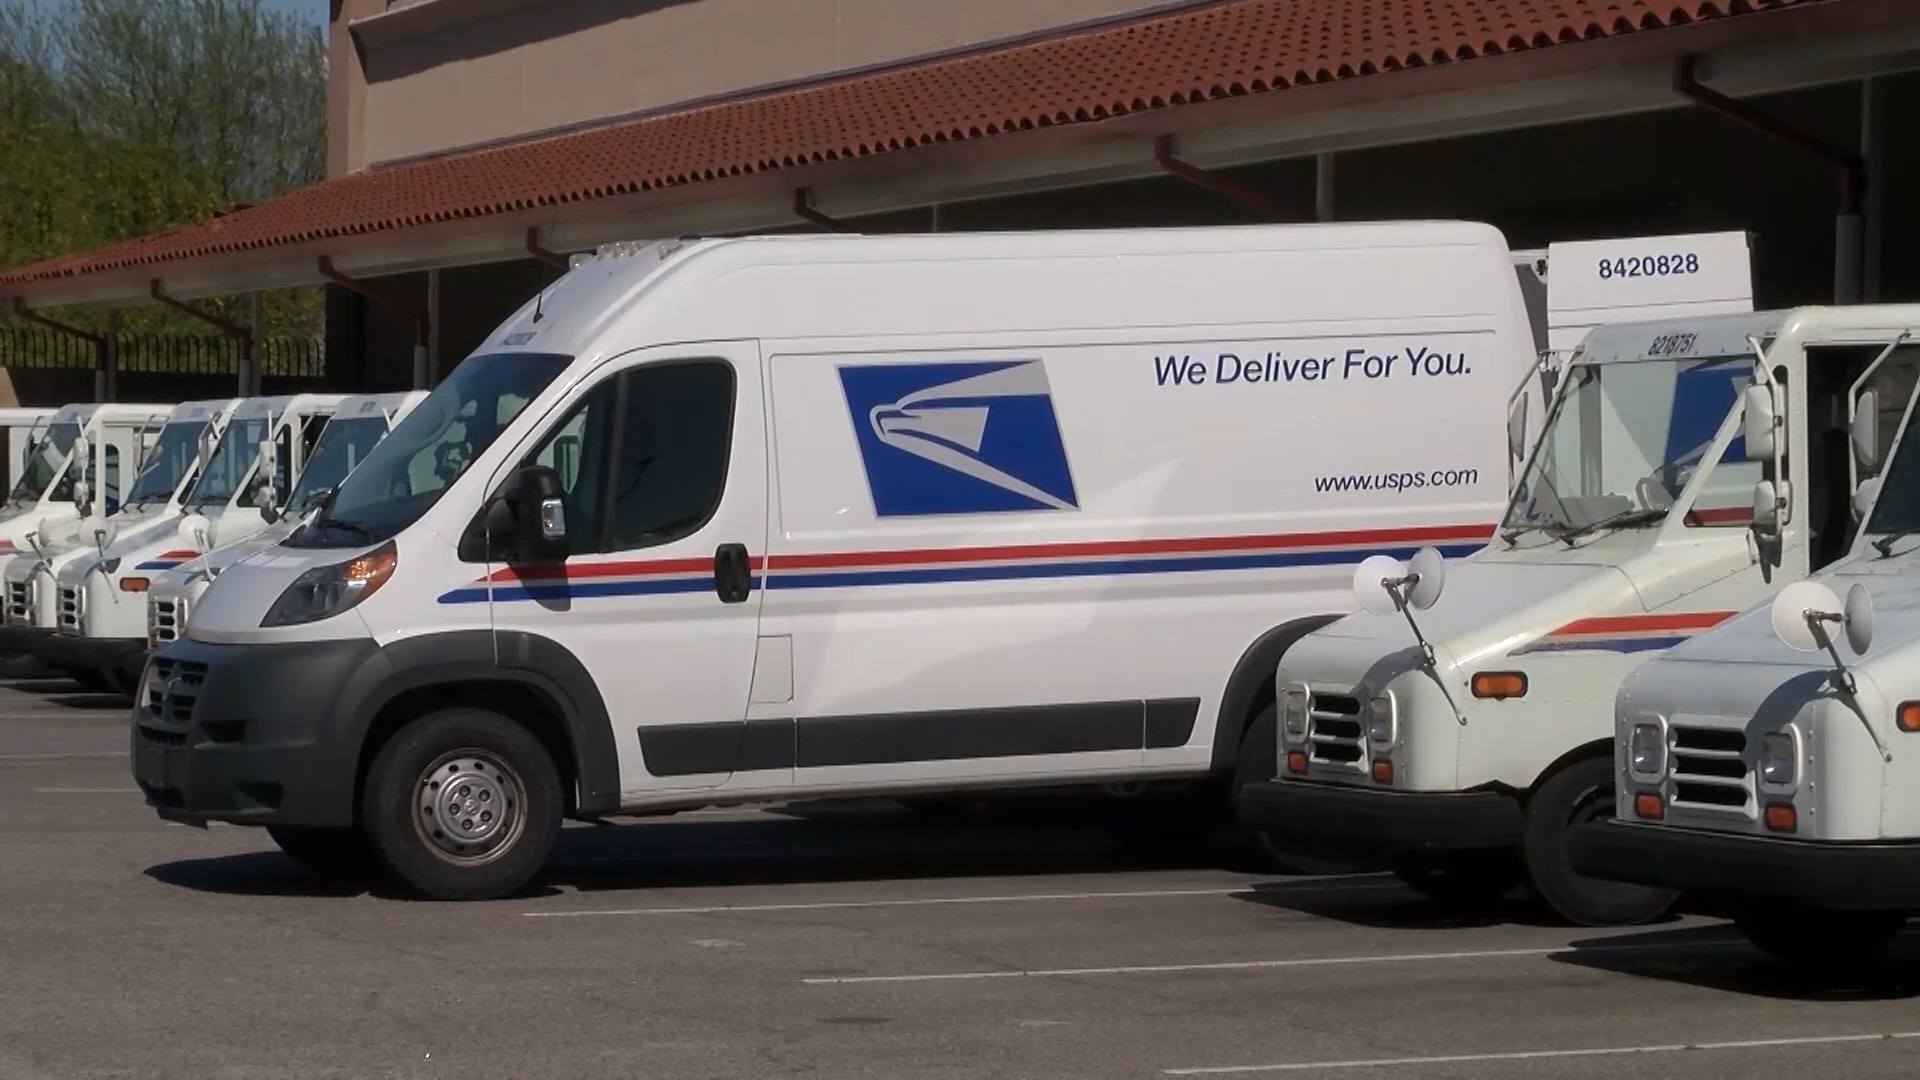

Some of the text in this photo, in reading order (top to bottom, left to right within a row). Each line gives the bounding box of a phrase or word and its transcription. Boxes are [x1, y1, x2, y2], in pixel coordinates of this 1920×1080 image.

[1599, 252, 1699, 280] 8420828
[1154, 346, 1472, 386] We Deliver For You.
[1314, 467, 1479, 494] www.usps.com
